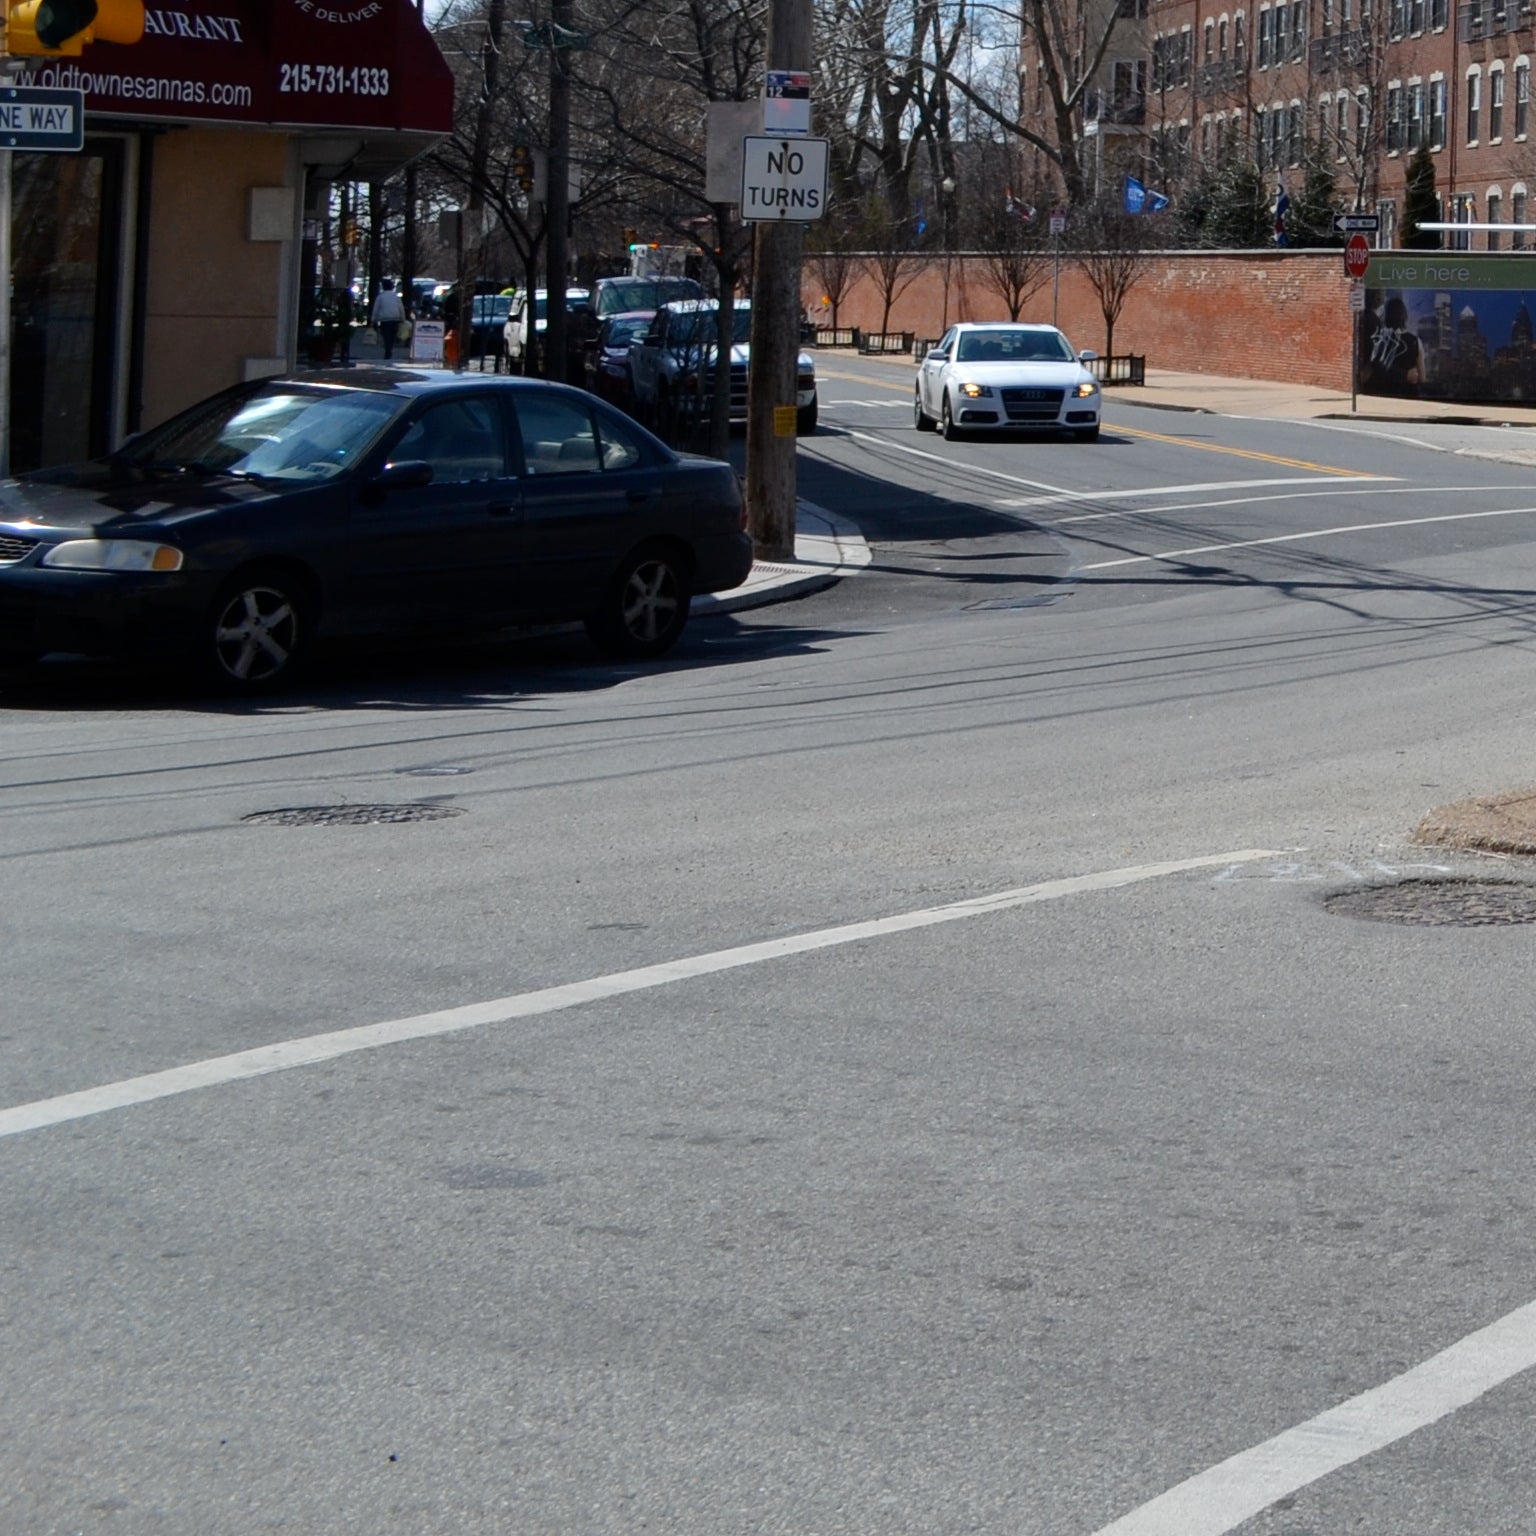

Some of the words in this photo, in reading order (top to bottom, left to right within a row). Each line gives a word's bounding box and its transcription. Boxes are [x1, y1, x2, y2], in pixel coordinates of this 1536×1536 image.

[316, 1, 383, 24] DELIVER
[280, 63, 389, 96] 215-731-1333
[768, 86, 783, 98] 12
[30, 107, 68, 131] WAY
[767, 151, 804, 175] NO
[748, 186, 820, 208] TURNS
[1349, 248, 1368, 265] STOP
[1378, 264, 1417, 281] Live
[1425, 264, 1470, 282] here
